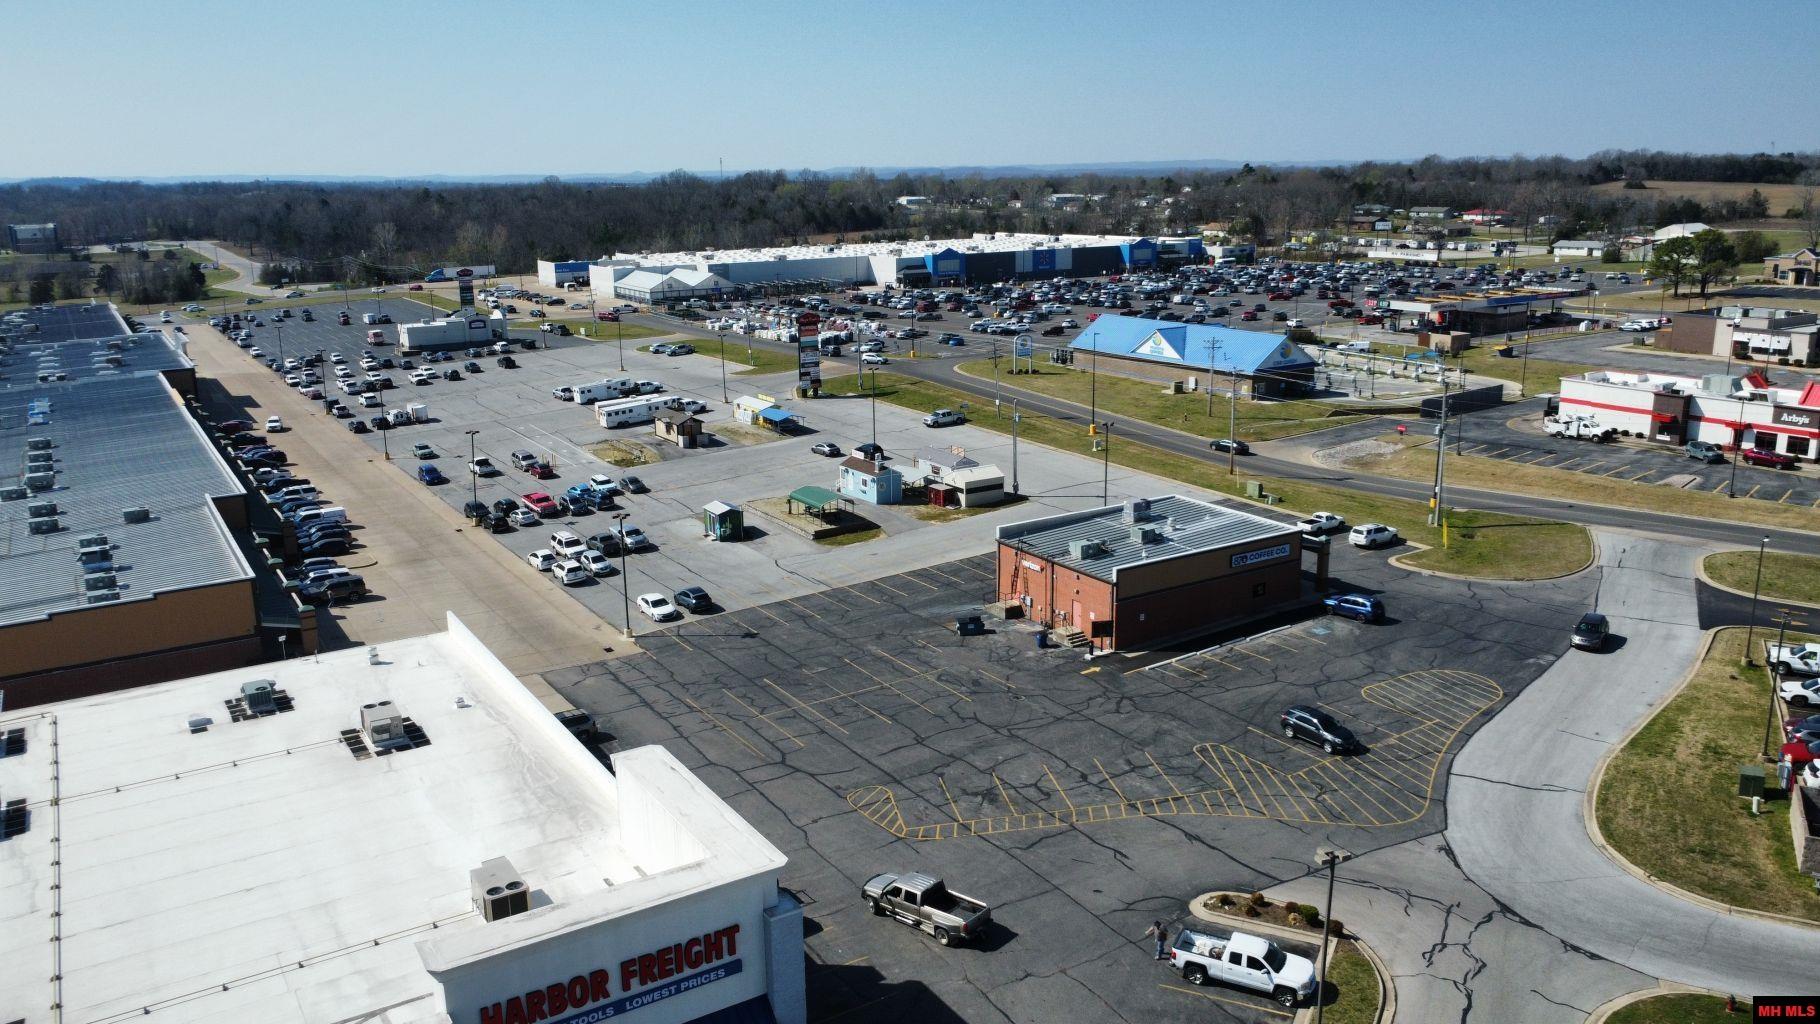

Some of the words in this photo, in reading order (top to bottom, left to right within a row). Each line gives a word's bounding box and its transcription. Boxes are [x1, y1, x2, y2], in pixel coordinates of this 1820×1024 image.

[1781, 413, 1810, 425] Arby's
[1249, 550, 1275, 561] COFFEE
[480, 968, 610, 1024] HARBOR
[620, 924, 740, 992] FREIGHT
[571, 1006, 615, 1024] TOOLS
[625, 985, 678, 1010] LOWEST
[680, 968, 726, 992] PRICES
